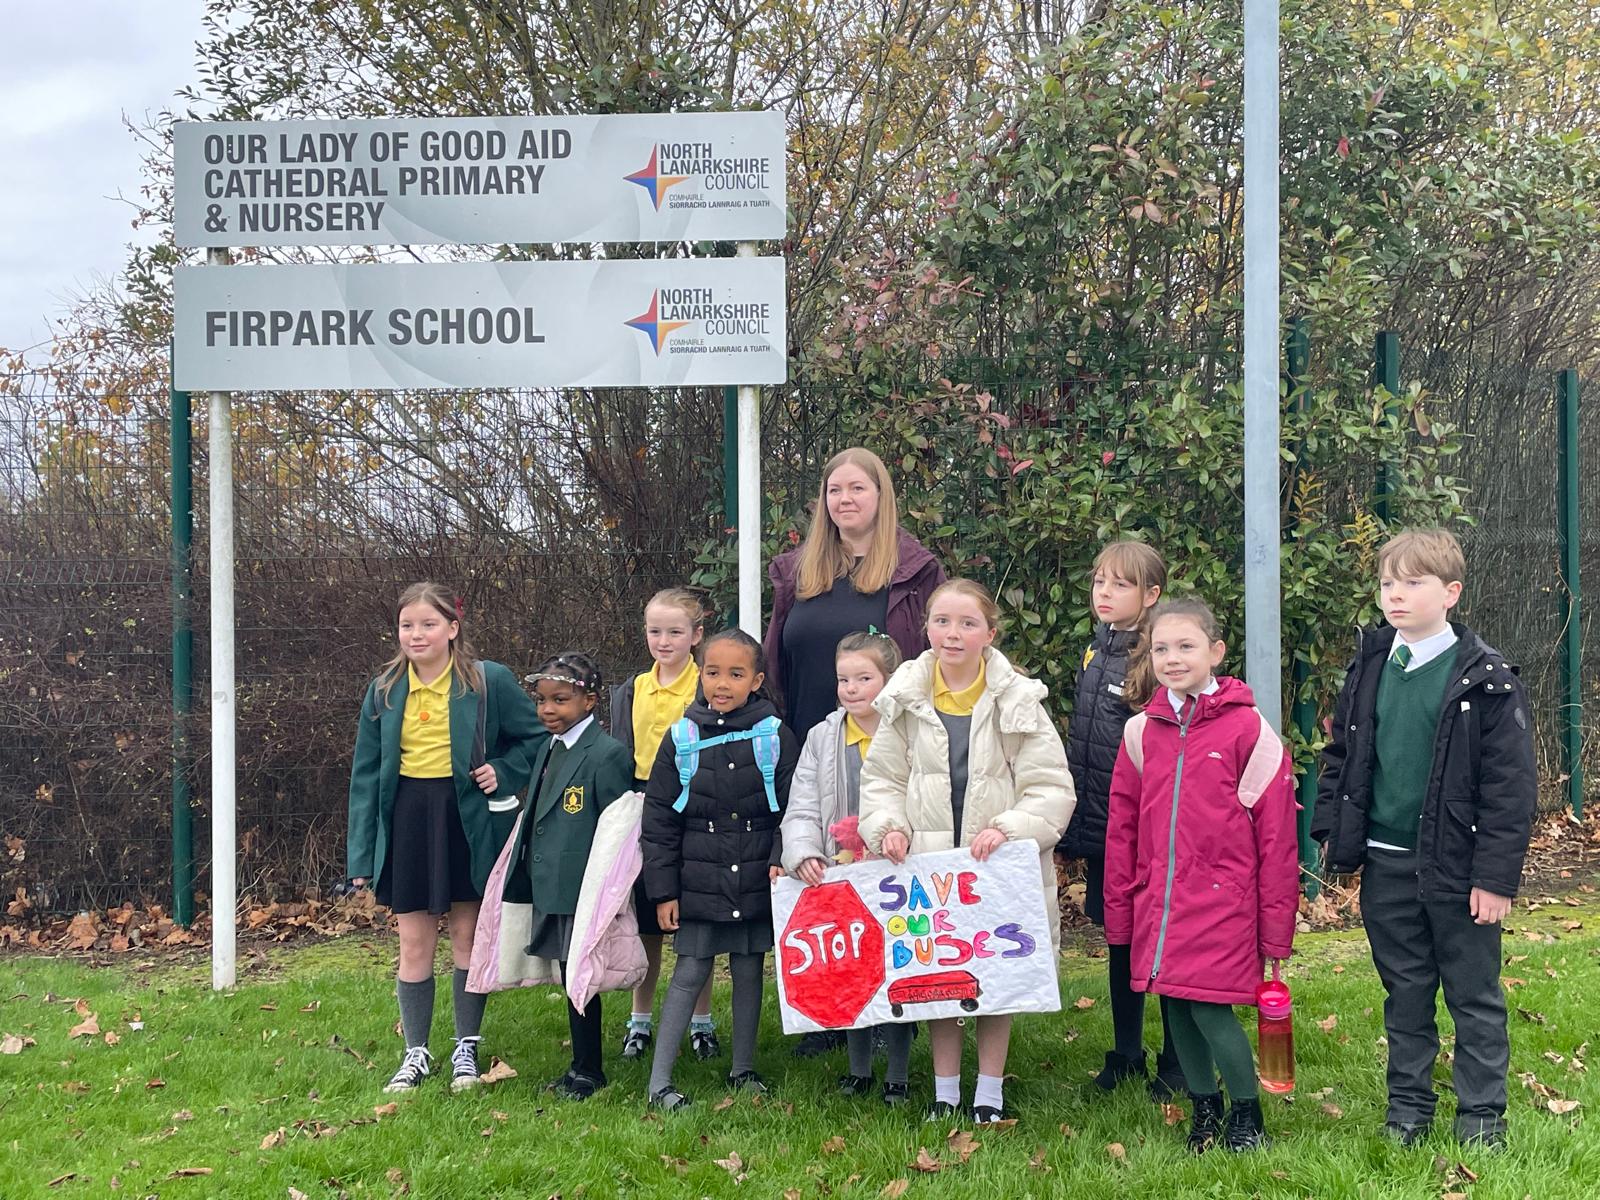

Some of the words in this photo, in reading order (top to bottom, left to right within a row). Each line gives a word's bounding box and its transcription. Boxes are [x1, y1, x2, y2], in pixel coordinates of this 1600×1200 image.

[204, 134, 267, 165] OUR
[280, 132, 358, 163] LADY
[369, 131, 409, 162] OF
[420, 130, 507, 161] GOOD
[517, 129, 572, 159] AID
[660, 143, 712, 159] NORTH
[660, 158, 770, 175] LANARKSHIRE
[204, 167, 388, 199] CATHEDRAL
[399, 165, 545, 196] PRIMARY
[704, 174, 770, 190] COUNCIL
[669, 201, 707, 209] SIORRACHD
[708, 200, 741, 208] LANNRAIG
[750, 200, 770, 208] TUATH
[204, 203, 227, 232] &
[239, 202, 385, 232] NURSERY
[660, 288, 713, 305] NORTH
[661, 303, 770, 320] LANARKSHIRE
[206, 310, 375, 347] FIRPARK
[388, 307, 545, 346] SCHOOL
[705, 319, 770, 335] COUNCIL
[669, 338, 704, 346] COMHAIRLE
[669, 346, 708, 354] SIORRACHD
[879, 871, 982, 912] SAVE
[887, 909, 956, 937] OUR
[785, 921, 865, 975] STOP
[892, 922, 1037, 970] BUSES
